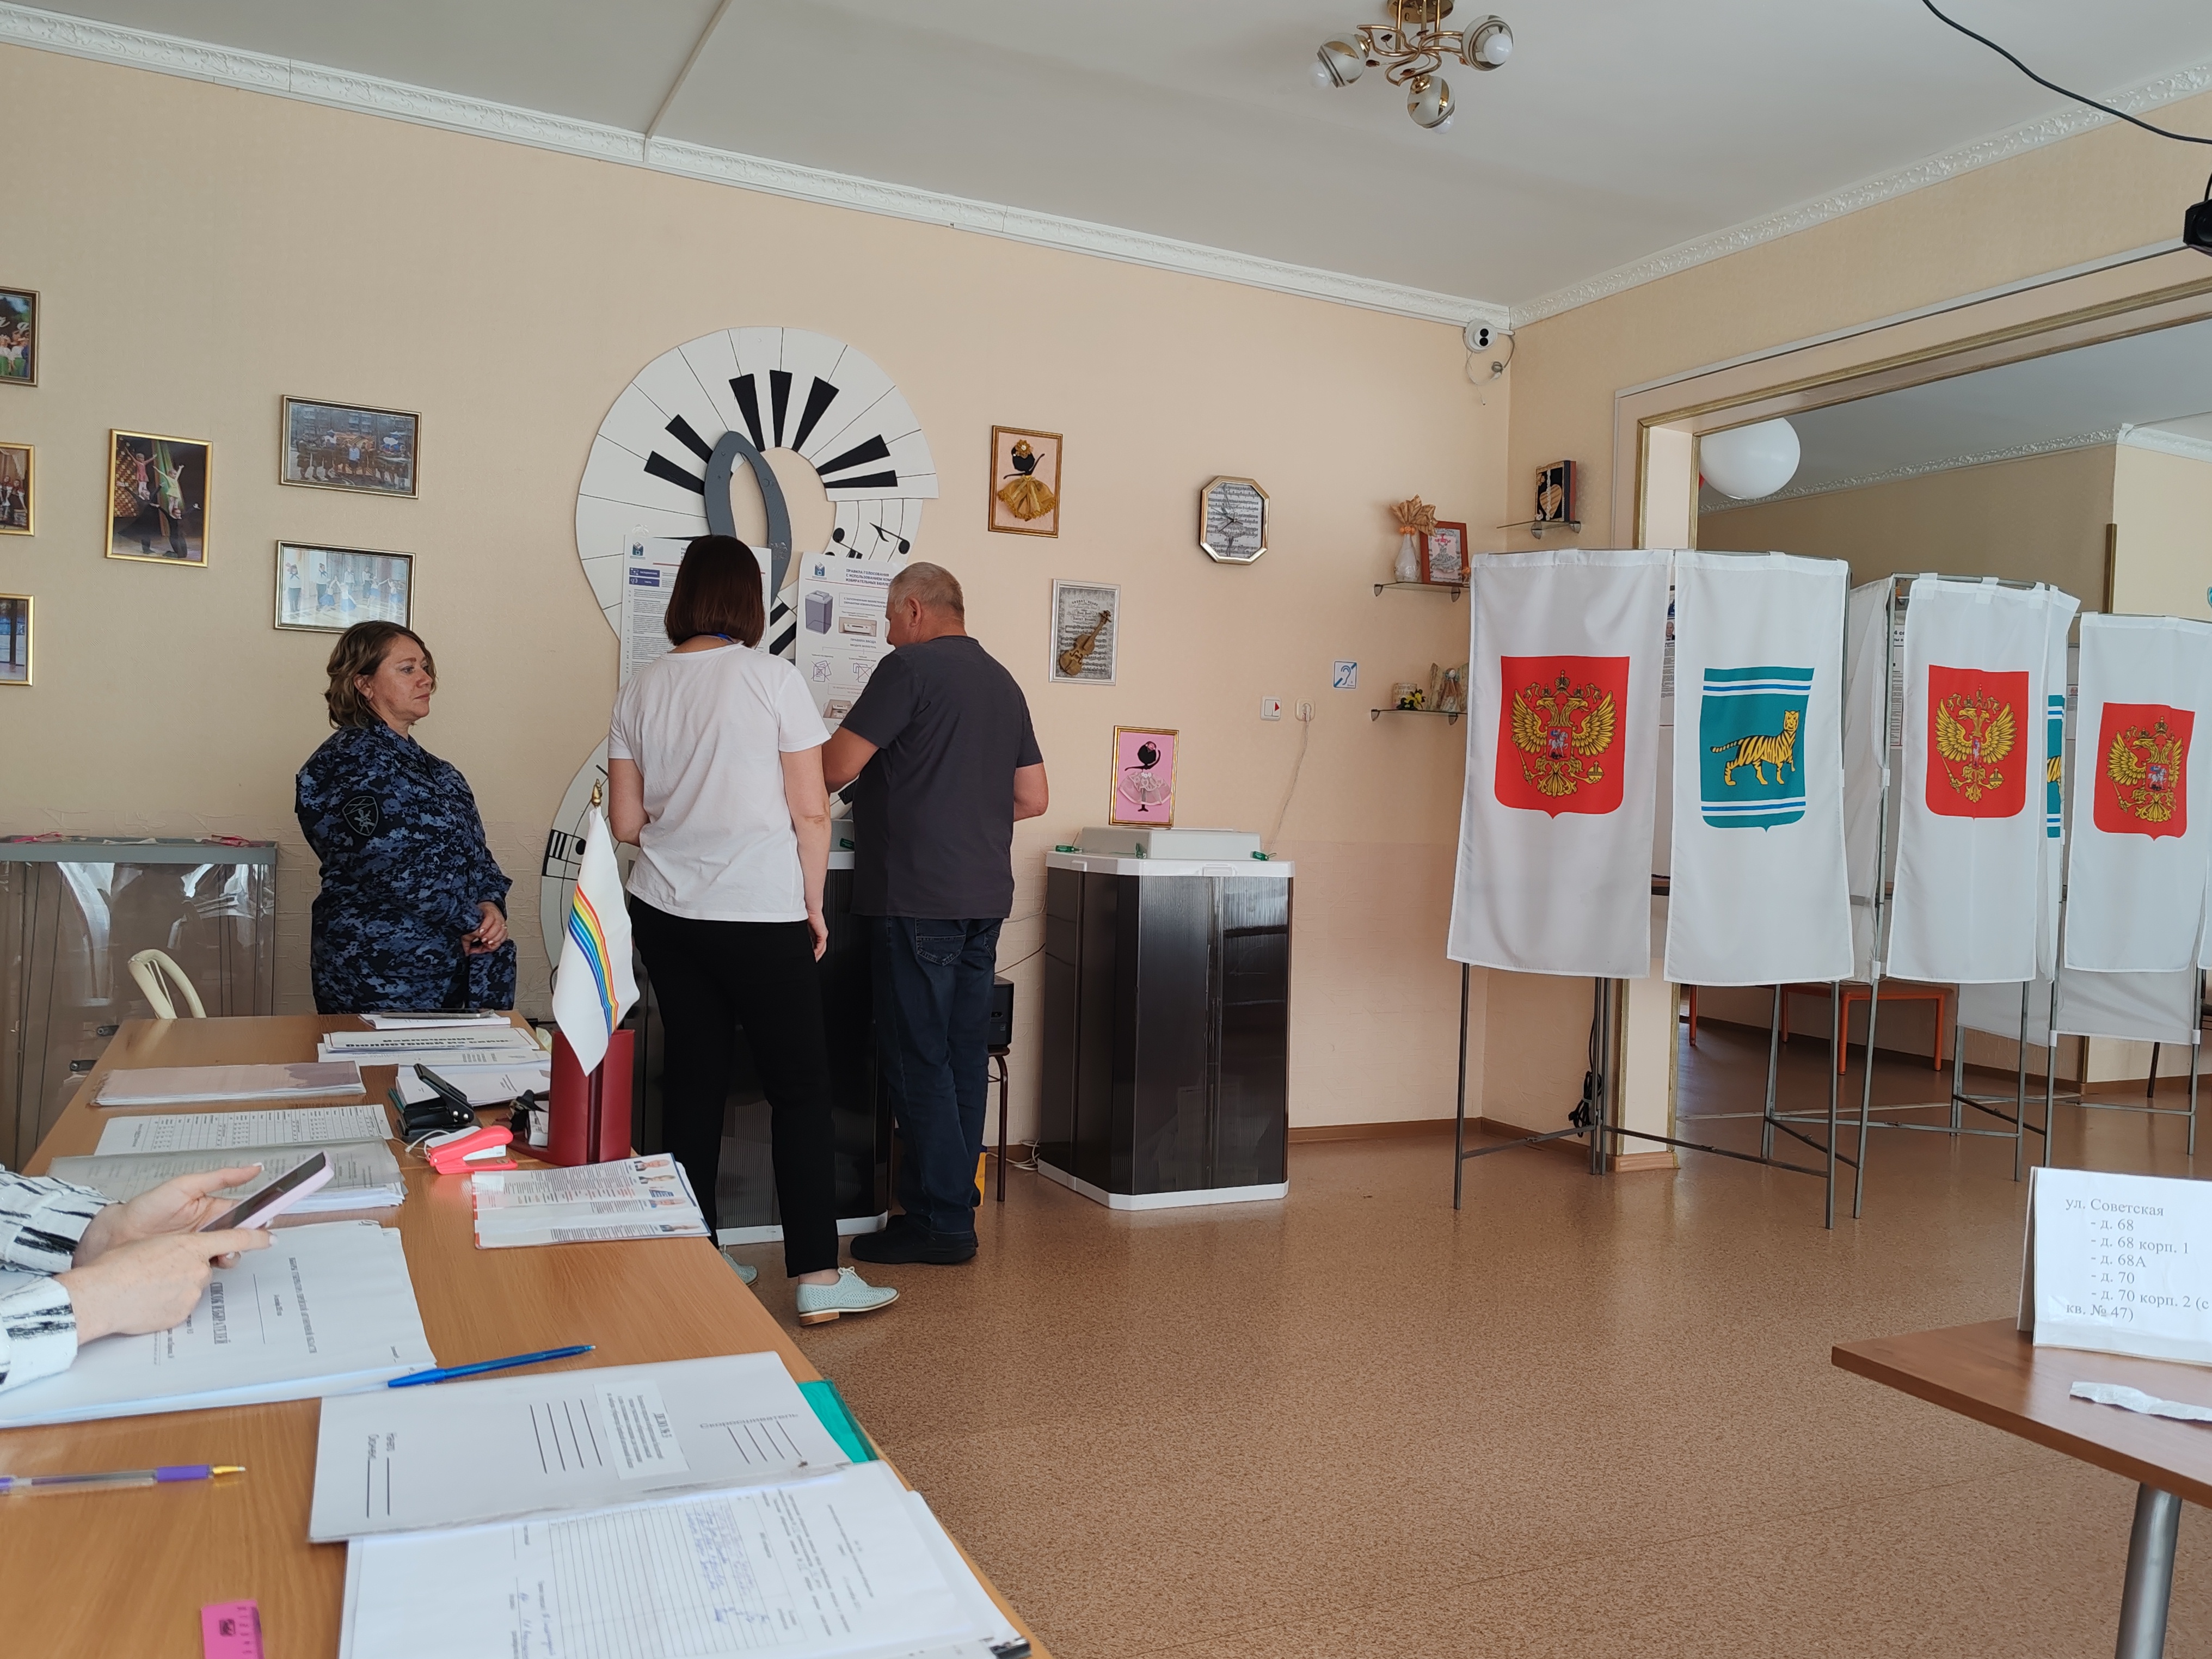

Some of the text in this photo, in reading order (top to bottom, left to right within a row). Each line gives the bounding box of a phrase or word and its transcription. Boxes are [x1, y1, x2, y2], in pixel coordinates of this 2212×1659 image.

[2066, 1199, 2164, 1216] ул. Советская
[2100, 1220, 2112, 1230] д.
[2117, 1218, 2134, 1231] 68
[2100, 1238, 2112, 1248] д.
[2117, 1236, 2134, 1249] 68
[2139, 1241, 2177, 1255] корп.
[2100, 1255, 2112, 1266] д.
[2118, 1254, 2147, 1268] 68А
[2100, 1273, 2113, 1283] д.
[2118, 1271, 2135, 1284] 70
[2100, 1291, 2113, 1301] д.
[2118, 1289, 2135, 1302] 70
[2140, 1294, 2178, 1308] корп.
[2183, 1295, 2191, 1308] 2
[2066, 1304, 2134, 1322] кв. № 47)
